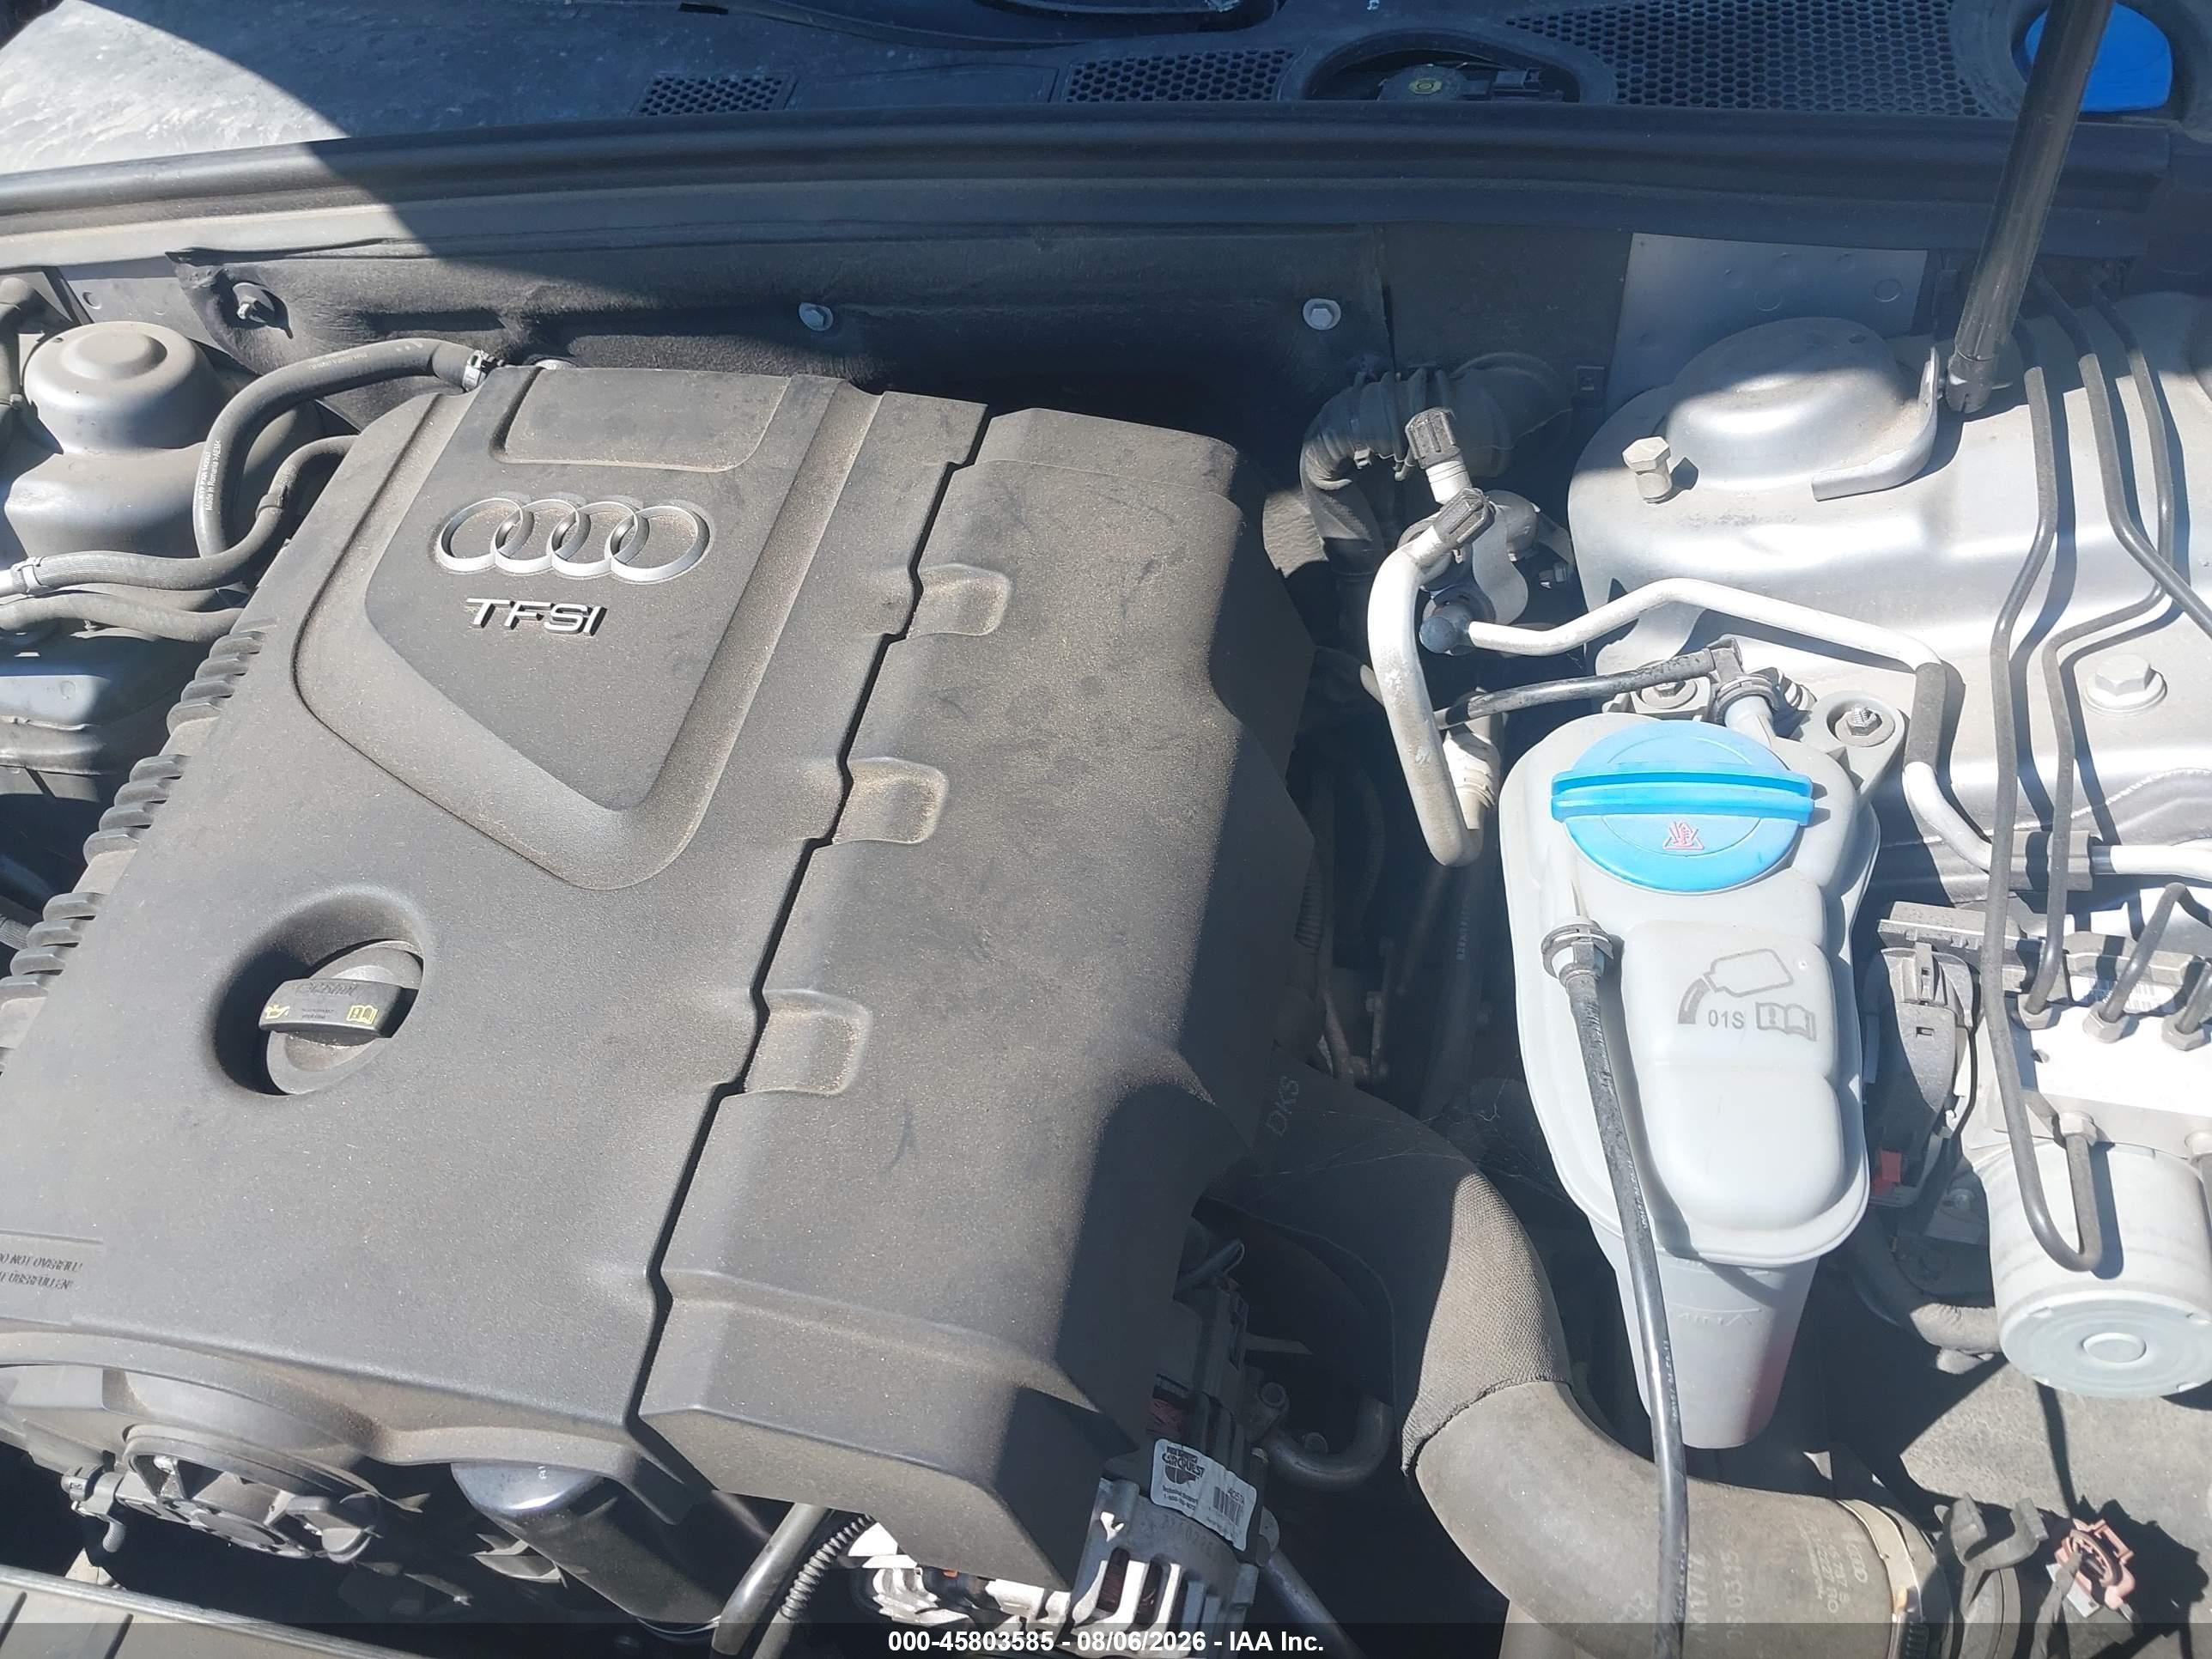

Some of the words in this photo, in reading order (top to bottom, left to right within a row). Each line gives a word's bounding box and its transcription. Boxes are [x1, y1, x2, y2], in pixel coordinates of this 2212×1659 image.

[207, 461, 219, 486] Romania
[466, 598, 607, 636] TFSI
[1708, 1009, 1744, 1030] 01S
[10, 1254, 31, 1267] NOT
[1162, 1452, 1206, 1478] CARQUEST
